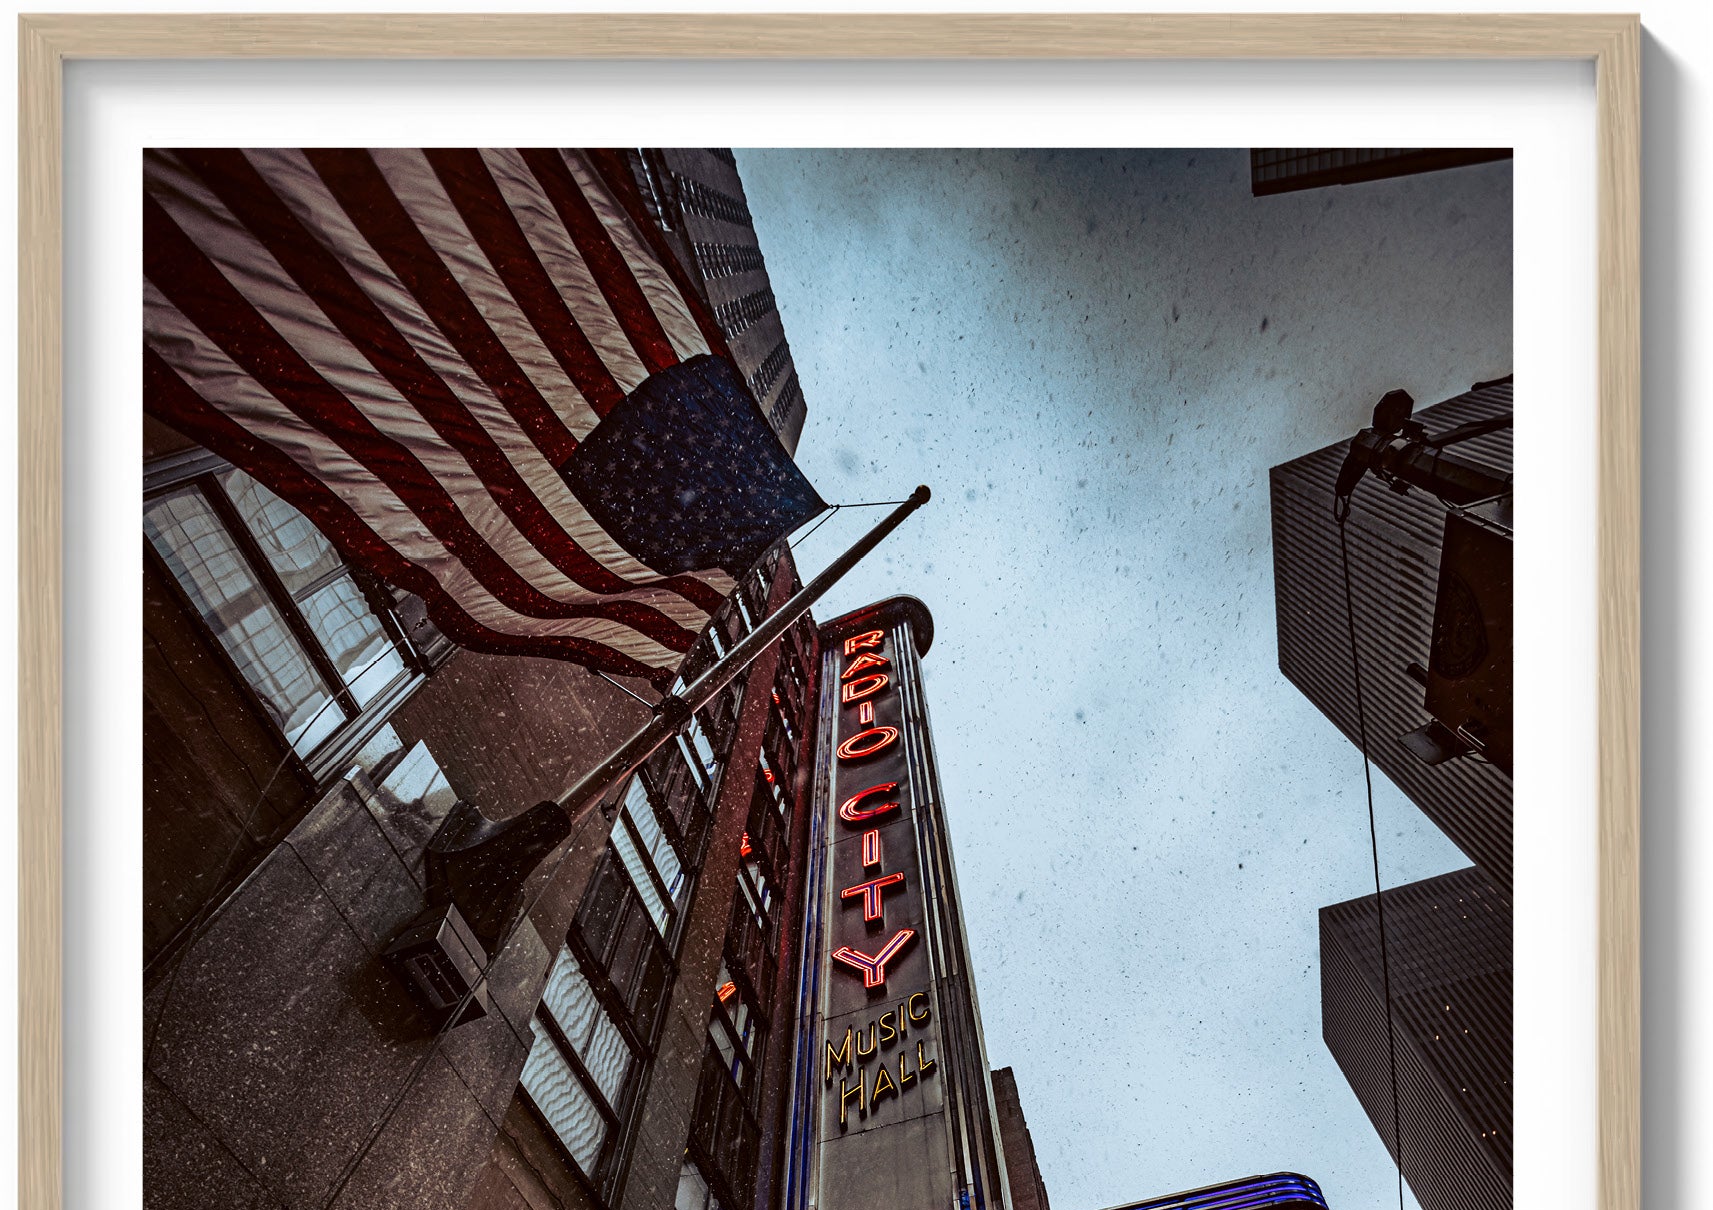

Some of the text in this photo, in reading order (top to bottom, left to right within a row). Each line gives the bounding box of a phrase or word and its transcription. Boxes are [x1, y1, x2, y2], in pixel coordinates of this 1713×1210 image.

[832, 630, 916, 988] RADIO CITY
[825, 991, 931, 1083] MUSIC
[840, 1040, 936, 1127] HALL
